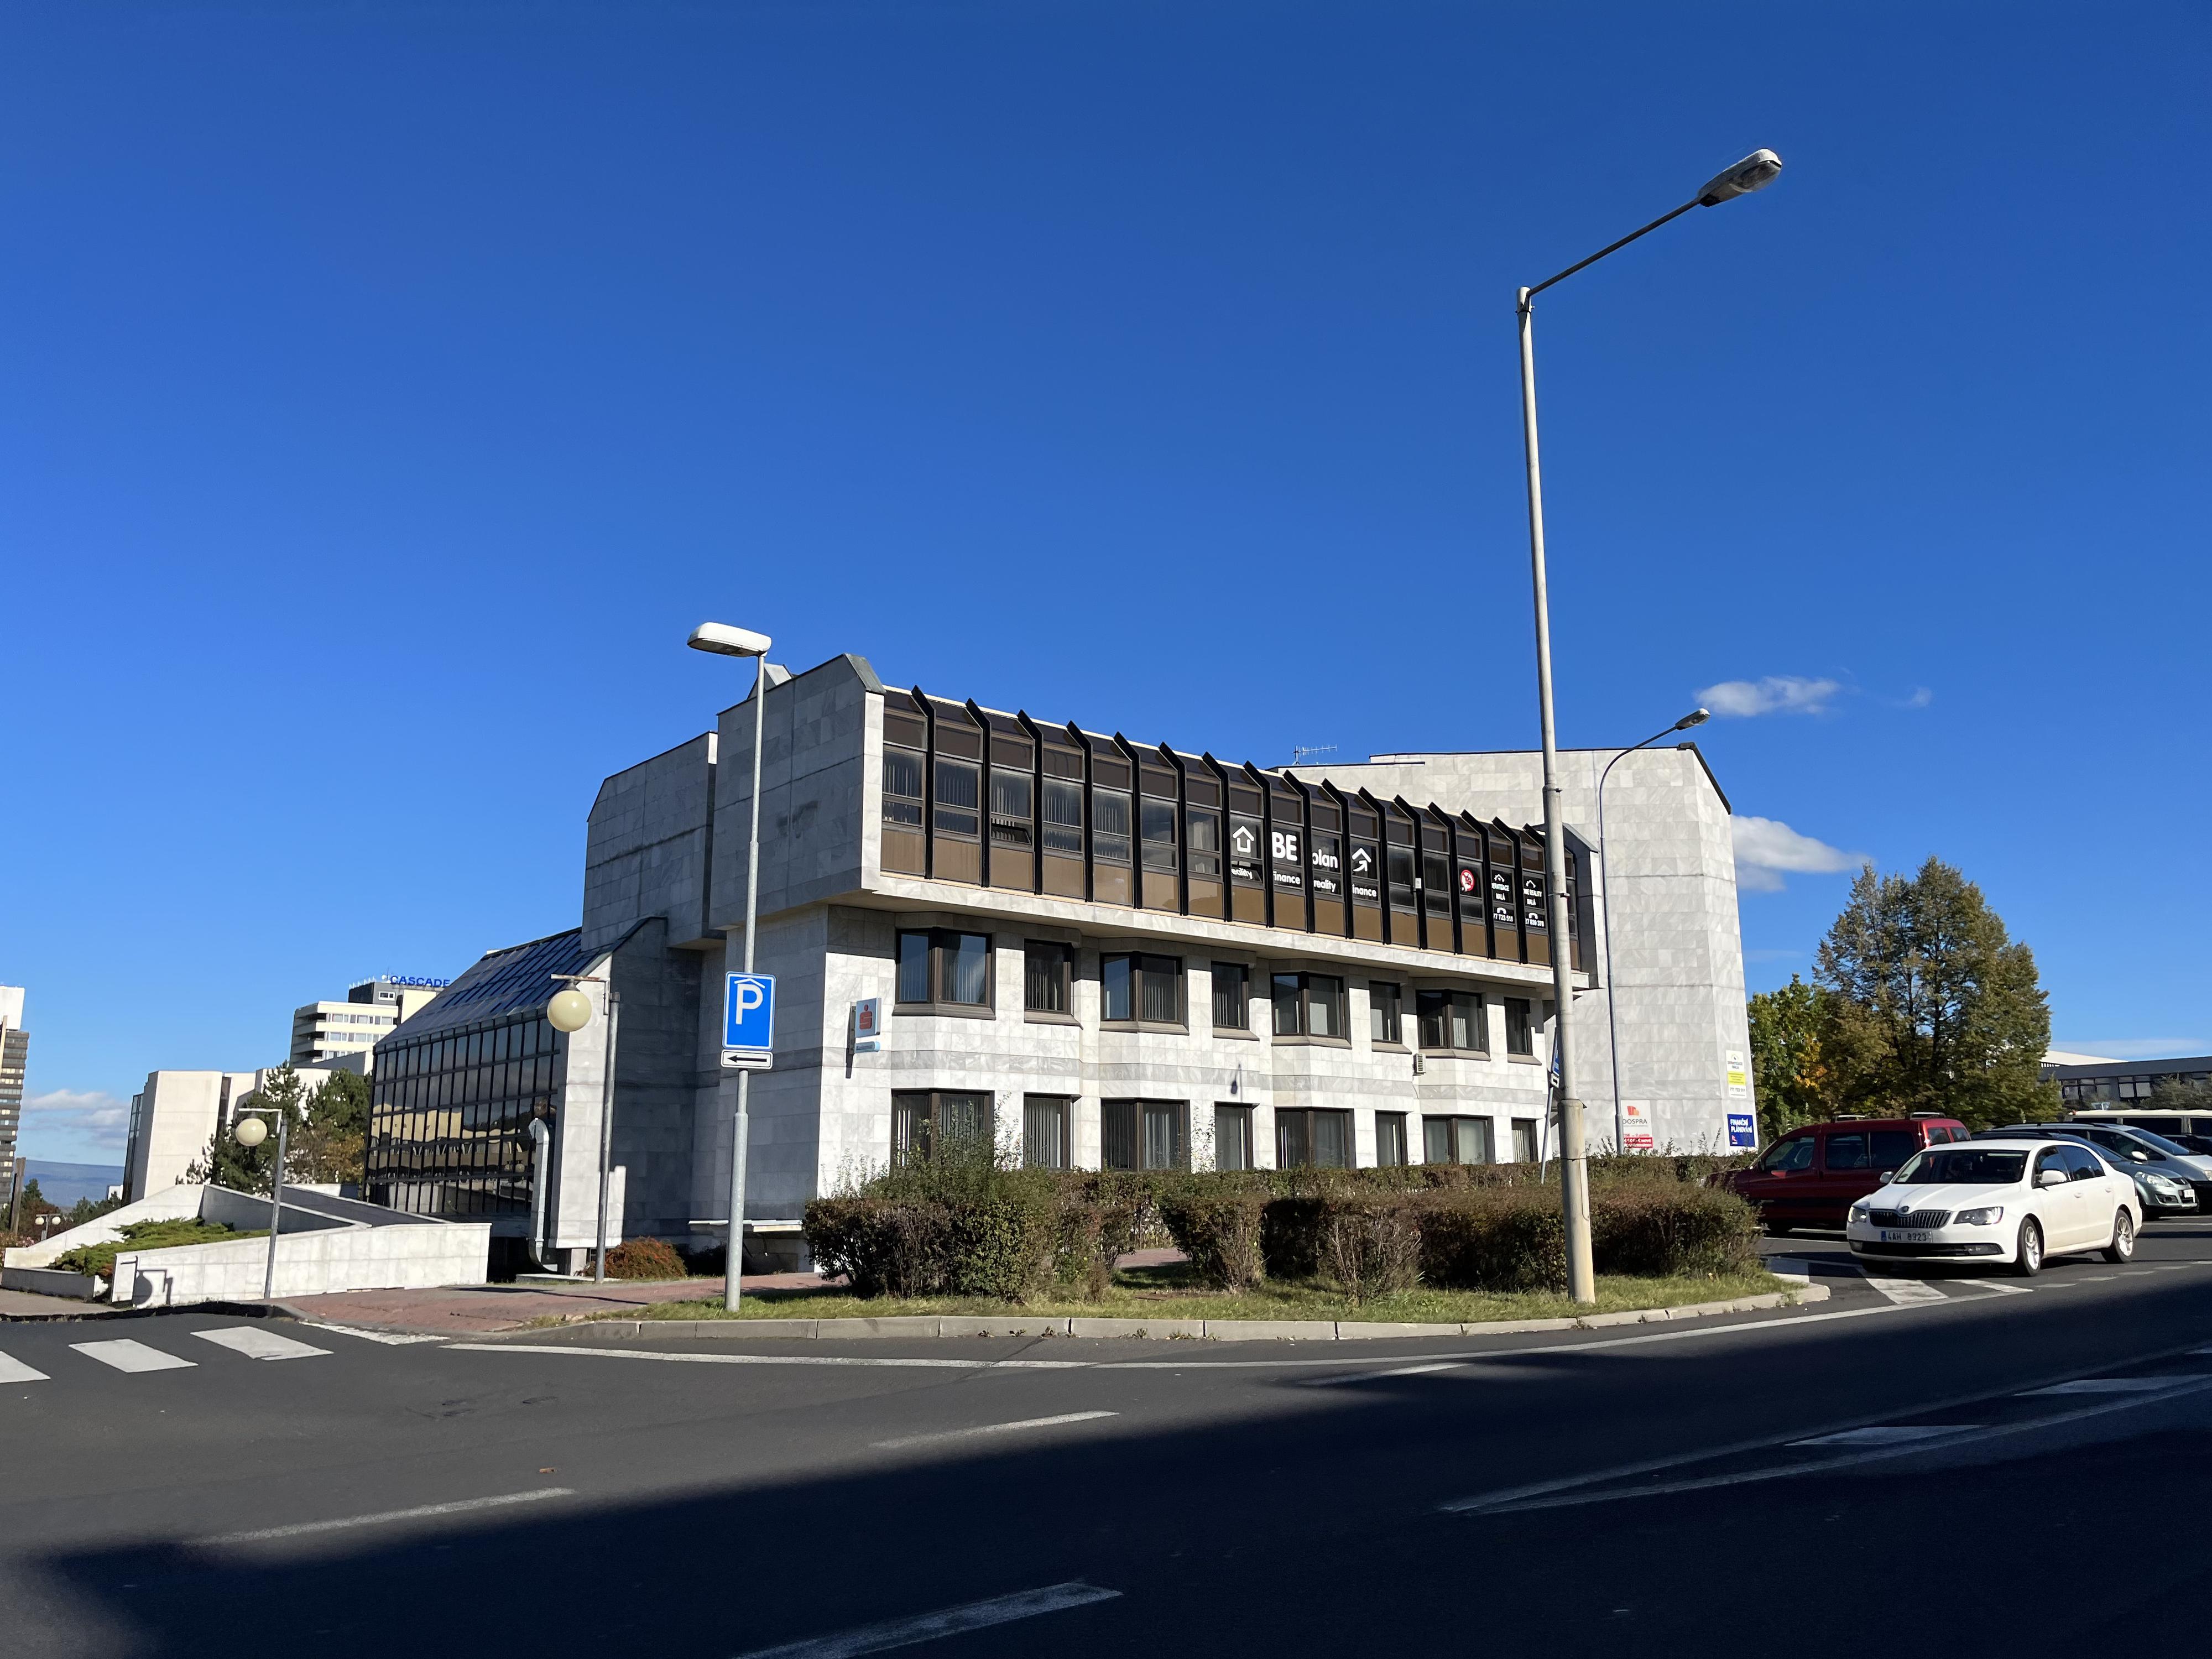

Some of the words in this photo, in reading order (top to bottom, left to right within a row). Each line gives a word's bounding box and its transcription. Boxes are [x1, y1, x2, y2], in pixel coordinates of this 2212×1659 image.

[1272, 831, 1297, 862] BE
[1231, 868, 1253, 879] eality
[1313, 879, 1336, 893] reality
[1352, 884, 1377, 897] inance
[390, 975, 450, 988] CASCADE
[735, 983, 763, 1025] P
